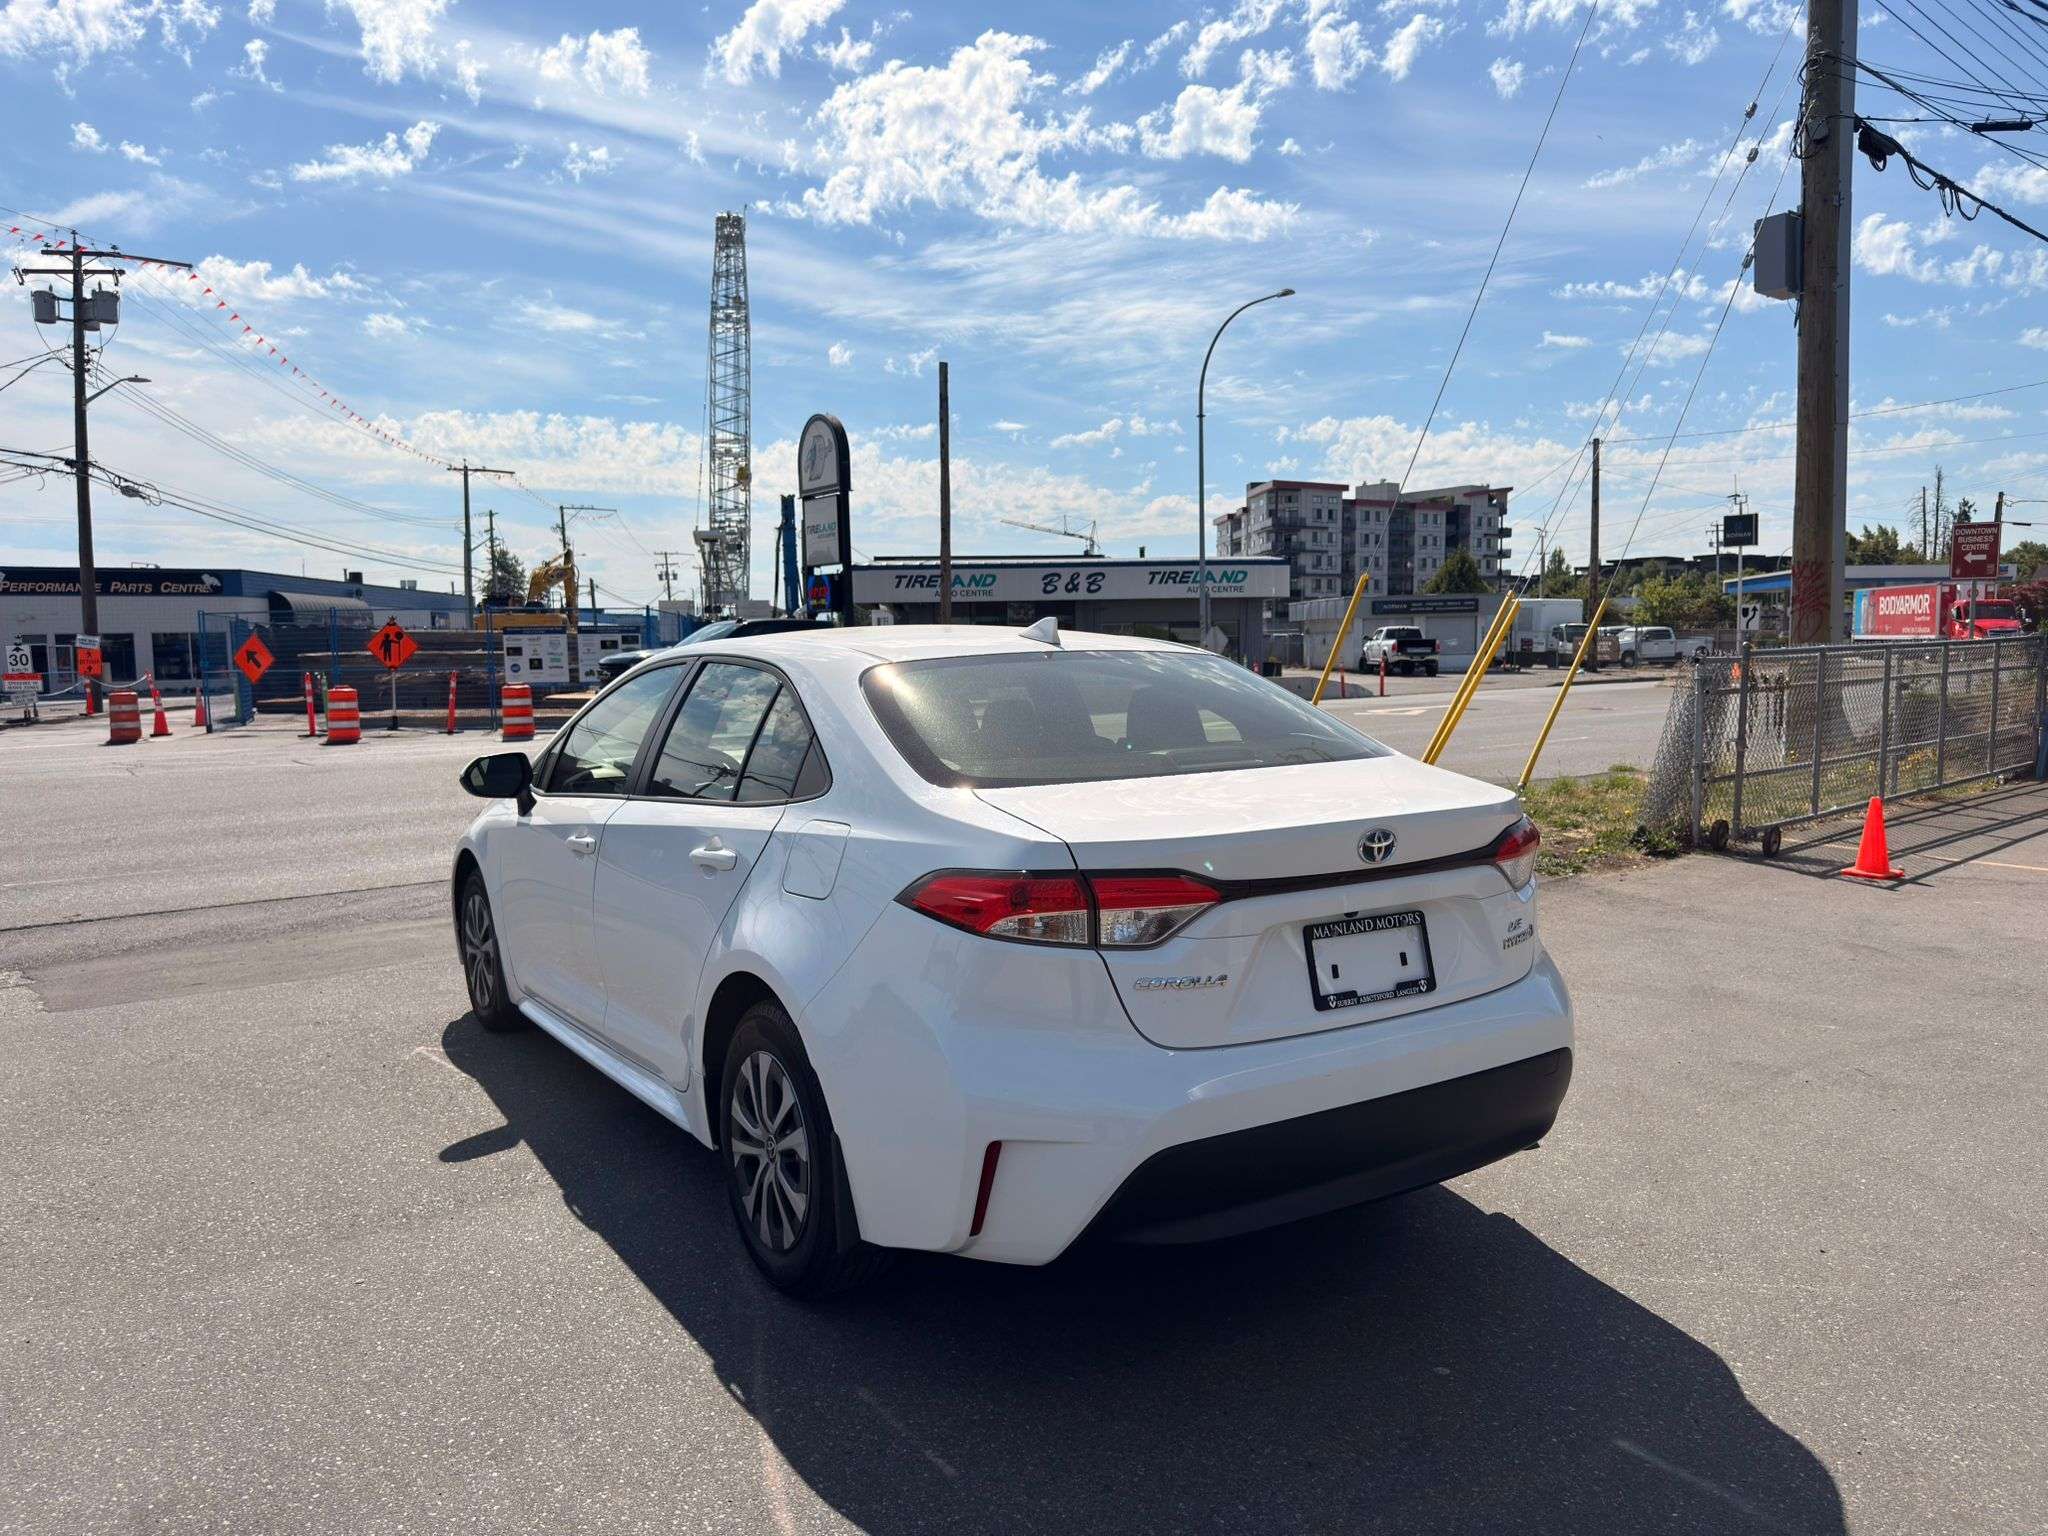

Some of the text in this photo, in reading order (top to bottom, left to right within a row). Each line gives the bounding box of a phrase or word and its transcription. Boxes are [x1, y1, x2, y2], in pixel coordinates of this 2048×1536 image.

[1955, 527, 1998, 536] DOWNTOWN
[1957, 535, 1994, 543] BUSINESS
[1961, 543, 1990, 551] CENTRE
[894, 573, 997, 589] TIREAND
[1041, 571, 1106, 594] B & B
[1149, 570, 1248, 584] TIRELAND
[0, 581, 210, 593] PERFORMANE PARTS CENTRE
[935, 589, 993, 598] AO CENTRE
[1211, 585, 1244, 593] CENTRE
[1879, 594, 1930, 615] BODYARMOR
[9, 653, 29, 667] 30
[1376, 911, 1421, 930] MOTORS
[1134, 974, 1228, 991] COROLLA
[1396, 987, 1419, 998] LANGLEY
